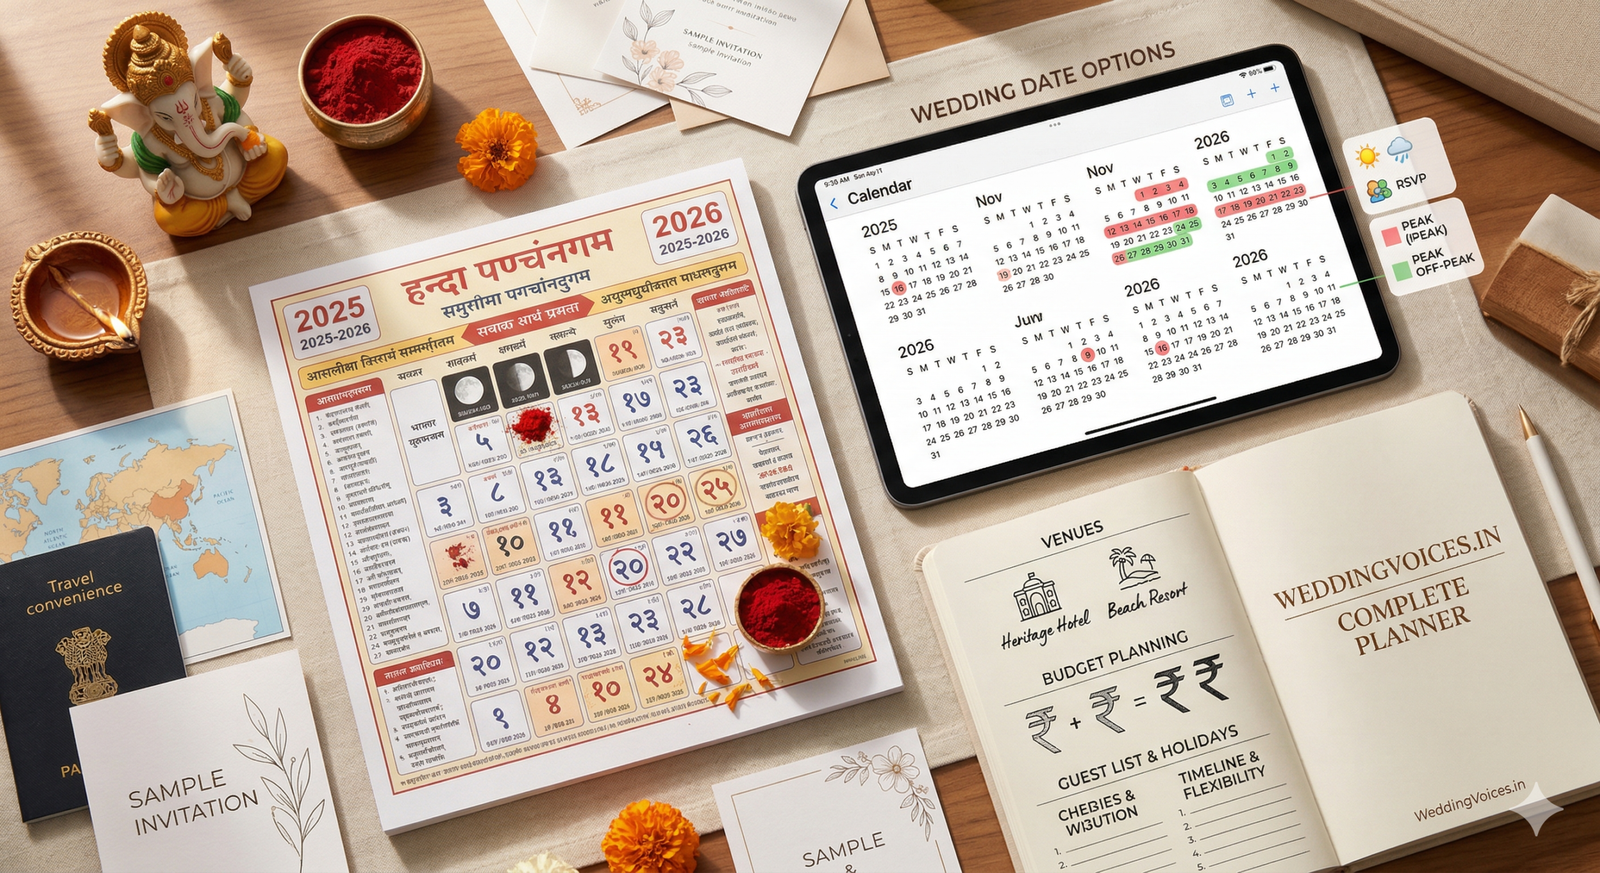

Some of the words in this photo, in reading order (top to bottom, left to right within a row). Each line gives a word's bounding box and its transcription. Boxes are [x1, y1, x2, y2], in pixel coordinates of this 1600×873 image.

[683, 28, 714, 44] SAMPLE
[716, 38, 764, 60] INVITATION
[911, 83, 1016, 123] WEDDING
[1021, 66, 1077, 96] DATE
[1081, 41, 1176, 79] OPTIONS
[1194, 130, 1230, 150] 2026
[840, 176, 850, 184] AM
[1087, 164, 1114, 178] Nov
[1211, 182, 1217, 190] 3
[1237, 175, 1243, 183] 5
[1249, 171, 1256, 179] 6
[1262, 168, 1267, 176] 7
[1274, 165, 1281, 173] 8
[1396, 172, 1427, 190] RSVP
[848, 180, 912, 204] Calendar
[975, 192, 1002, 208] Nov
[652, 201, 723, 238] 2026
[861, 218, 898, 238] 2025
[1120, 224, 1129, 232] 13
[1159, 213, 1169, 221] 16
[1401, 214, 1434, 231] PEAK
[658, 228, 730, 256] 2025-2026
[1233, 249, 1268, 268] 2026
[1412, 248, 1444, 264] PEAK
[1416, 252, 1475, 277] OFF-PEAK
[1002, 284, 1014, 293] 26
[1016, 280, 1026, 289] 27
[1029, 276, 1041, 285] 28
[1043, 273, 1054, 282] 30
[1125, 278, 1160, 297] 2026
[294, 296, 365, 333] 2025
[300, 322, 371, 351] 2025-2026
[658, 326, 687, 349] २३
[898, 339, 934, 359] 2026
[1144, 347, 1154, 356] 15
[1158, 344, 1168, 352] 16
[1171, 340, 1180, 348] 17
[1184, 336, 1193, 345] 17
[1197, 333, 1207, 341] 19
[1210, 329, 1221, 338] 20
[1223, 326, 1233, 335] 21
[571, 403, 600, 427] १३
[622, 391, 651, 413] १७
[672, 375, 702, 398] २३
[437, 496, 452, 517] ३
[491, 482, 505, 502] ८
[534, 467, 564, 491] १३
[586, 453, 615, 478] १८
[687, 425, 719, 448] २६
[496, 535, 524, 557] १०
[601, 504, 628, 529] ११
[650, 493, 680, 514] २०
[1041, 520, 1104, 549] VENUES
[48, 570, 94, 594] Travel
[462, 601, 481, 620] ७
[510, 583, 538, 609] ११
[562, 570, 592, 595] १२
[613, 558, 644, 580] २०
[665, 542, 697, 566] २२
[716, 529, 747, 552] २७
[1273, 526, 1502, 610] WEDDINGVOICES.IN
[26, 582, 123, 616] convenience
[1108, 593, 1147, 619] Beach
[1149, 582, 1188, 606] Resort
[1337, 576, 1470, 632] COMPLETE
[470, 655, 501, 677] २०
[524, 637, 555, 663] १२
[577, 622, 607, 649] १३
[628, 609, 660, 634] २३
[680, 594, 712, 619] २८
[1001, 628, 1054, 650] Heritage
[1057, 609, 1091, 632] Hotel
[1355, 605, 1471, 656] PLANNER
[1042, 656, 1106, 686] BUDGET
[1109, 630, 1189, 666] PLANNING
[492, 708, 509, 730] १
[591, 680, 621, 703] १०
[642, 662, 674, 688] २४
[1057, 765, 1108, 791] GUEST
[1111, 754, 1143, 774] LIST
[1147, 750, 1159, 763] &
[1160, 724, 1239, 759] HOLIDAYS
[1178, 753, 1246, 784] TIMELINE
[1249, 750, 1260, 763] &
[128, 769, 226, 809] SAMPLE
[1183, 764, 1266, 800] FLEXIBILITY
[135, 790, 258, 836] INVITATION
[1058, 792, 1122, 822] CHEBIES
[1125, 789, 1136, 802] &
[1414, 779, 1526, 822] WeddingVoices.in
[802, 831, 886, 867] SAMPLE
